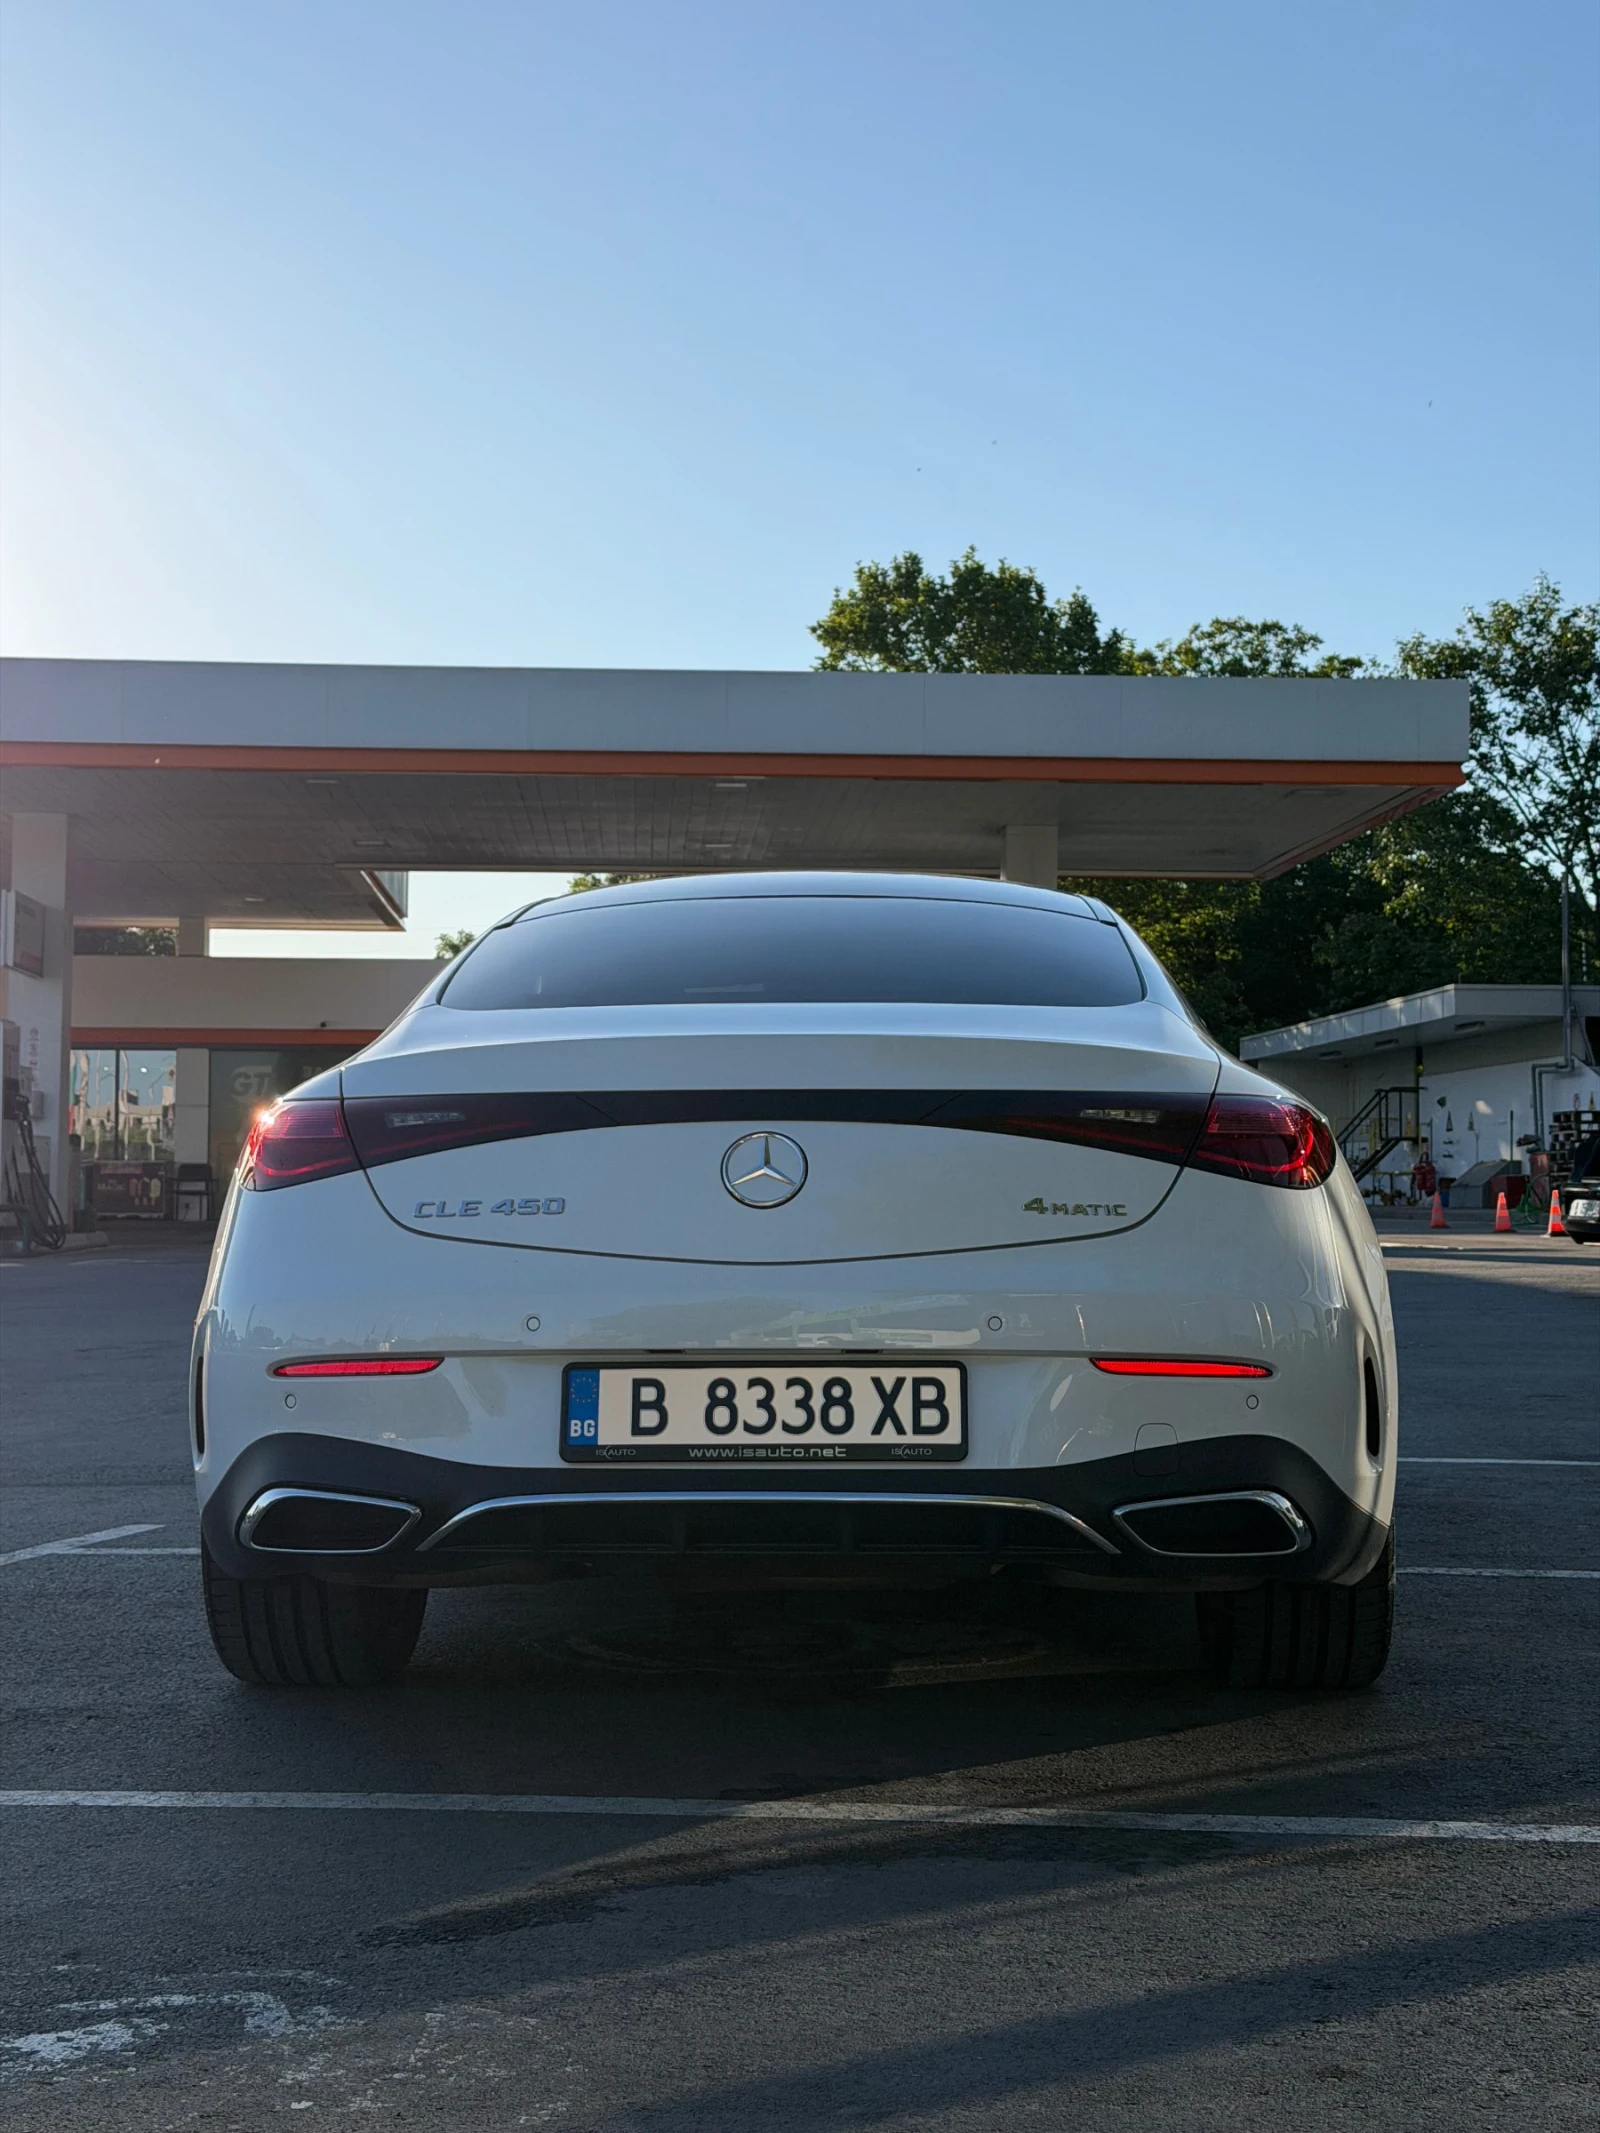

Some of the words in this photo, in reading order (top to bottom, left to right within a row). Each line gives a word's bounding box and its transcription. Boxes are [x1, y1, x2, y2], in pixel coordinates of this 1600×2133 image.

[413, 1200, 483, 1218] CLE
[490, 1197, 566, 1216] 450
[631, 1378, 668, 1437] B
[705, 1376, 855, 1436] 8338
[870, 1376, 951, 1436] XB
[570, 1419, 596, 1437] BG
[688, 1446, 847, 1458] www.isauto.net
